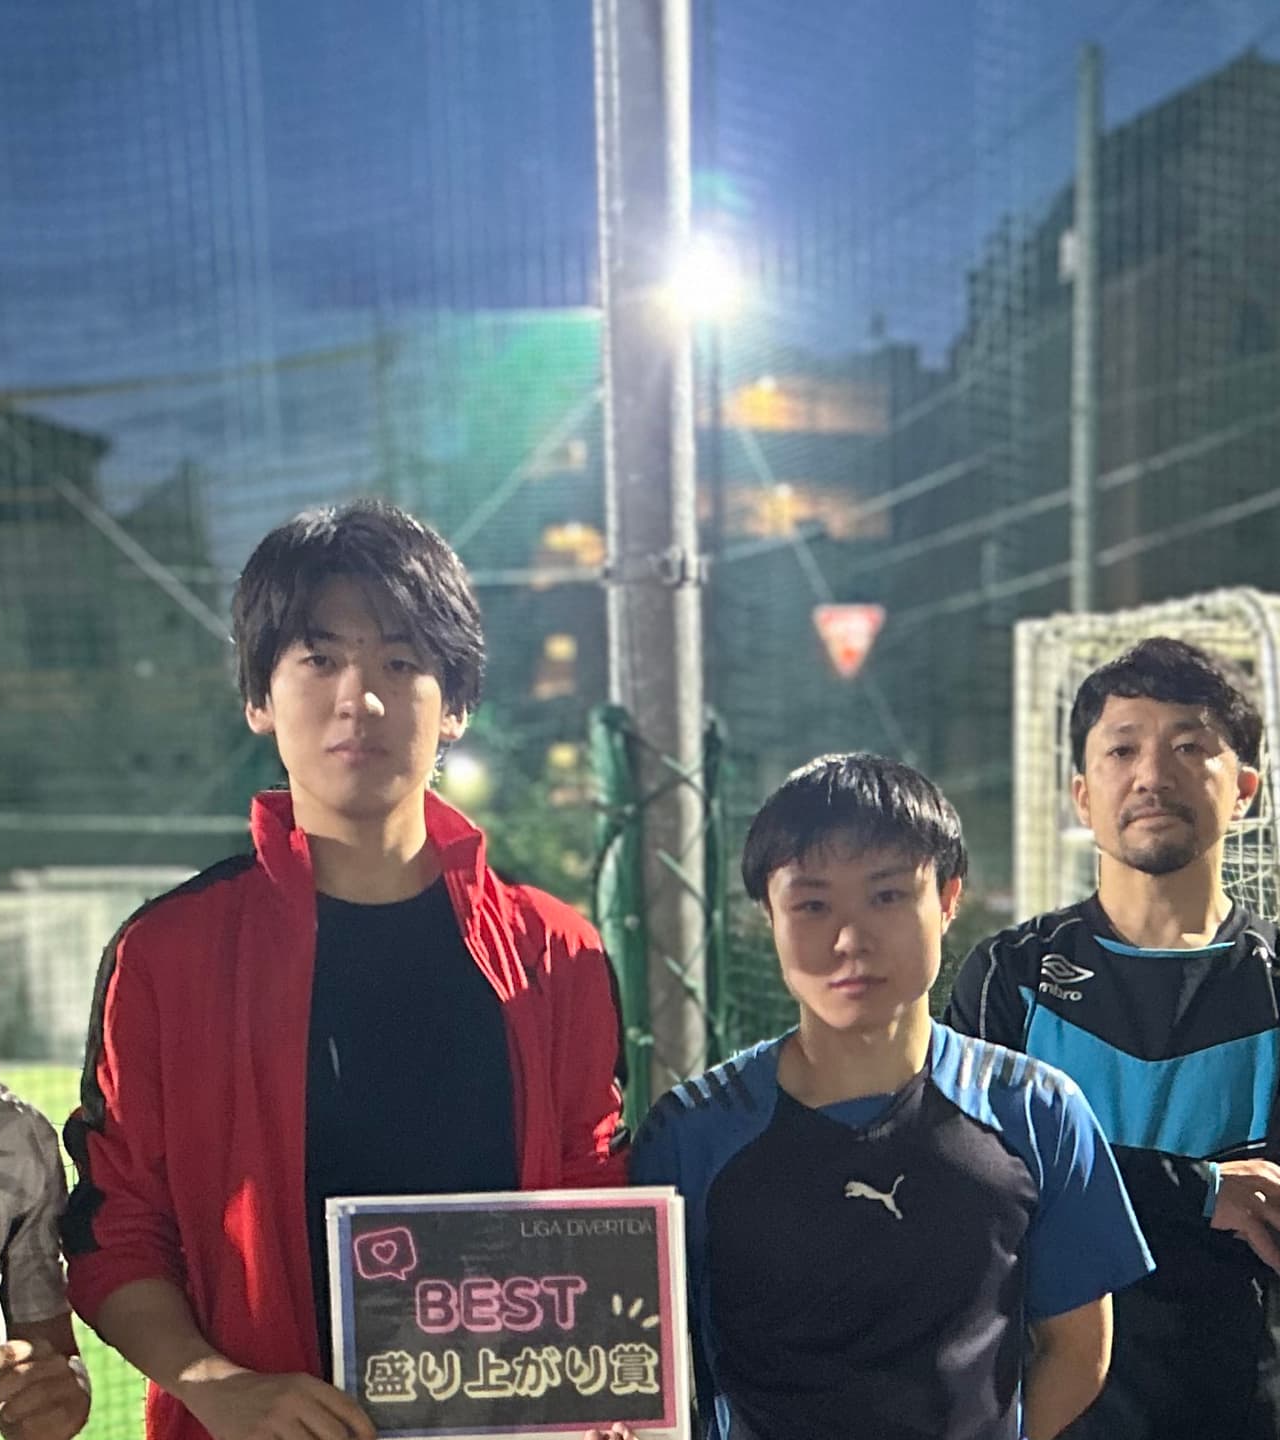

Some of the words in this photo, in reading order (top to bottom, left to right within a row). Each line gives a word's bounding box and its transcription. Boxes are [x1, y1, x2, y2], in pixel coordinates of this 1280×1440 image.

[1039, 982, 1082, 1001] mbro
[415, 1275, 588, 1334] BEST
[365, 1343, 660, 1402] 盛り上がり賞
